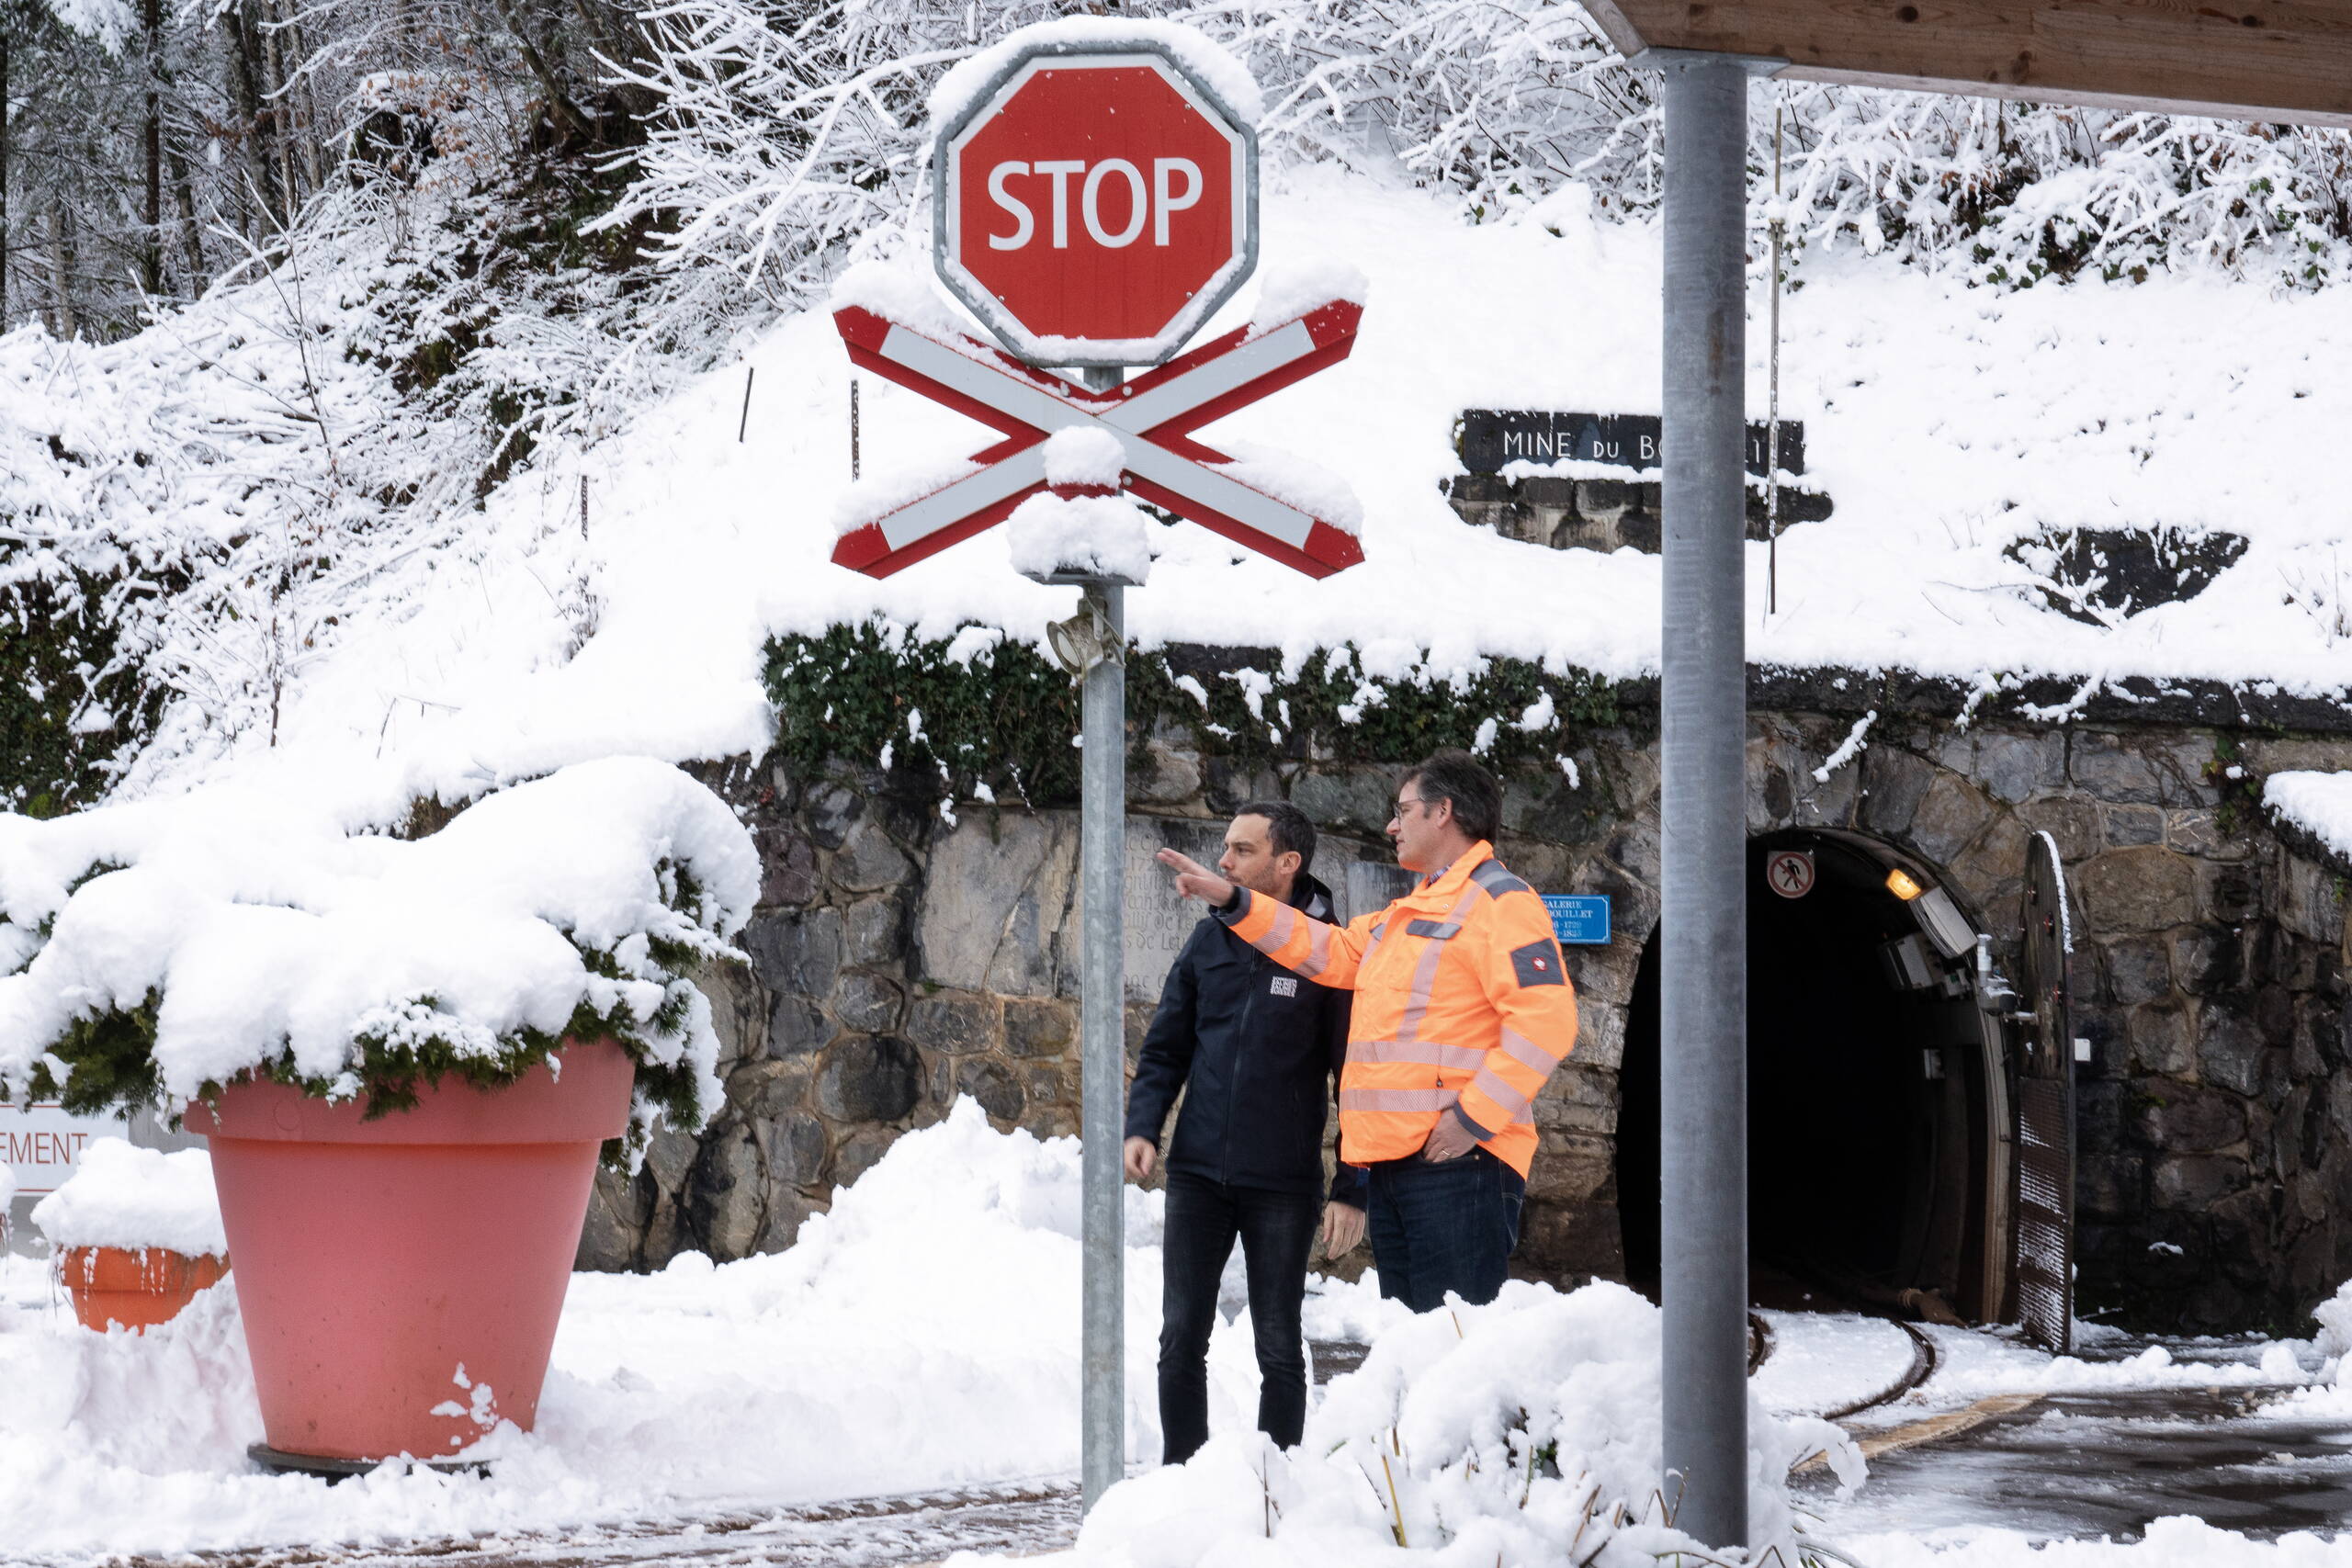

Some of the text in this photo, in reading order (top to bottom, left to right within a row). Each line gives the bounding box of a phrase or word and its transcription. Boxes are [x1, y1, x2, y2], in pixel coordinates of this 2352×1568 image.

[988, 158, 1204, 251] STOP
[1504, 430, 1571, 457] MINE
[1593, 440, 1619, 458] DU
